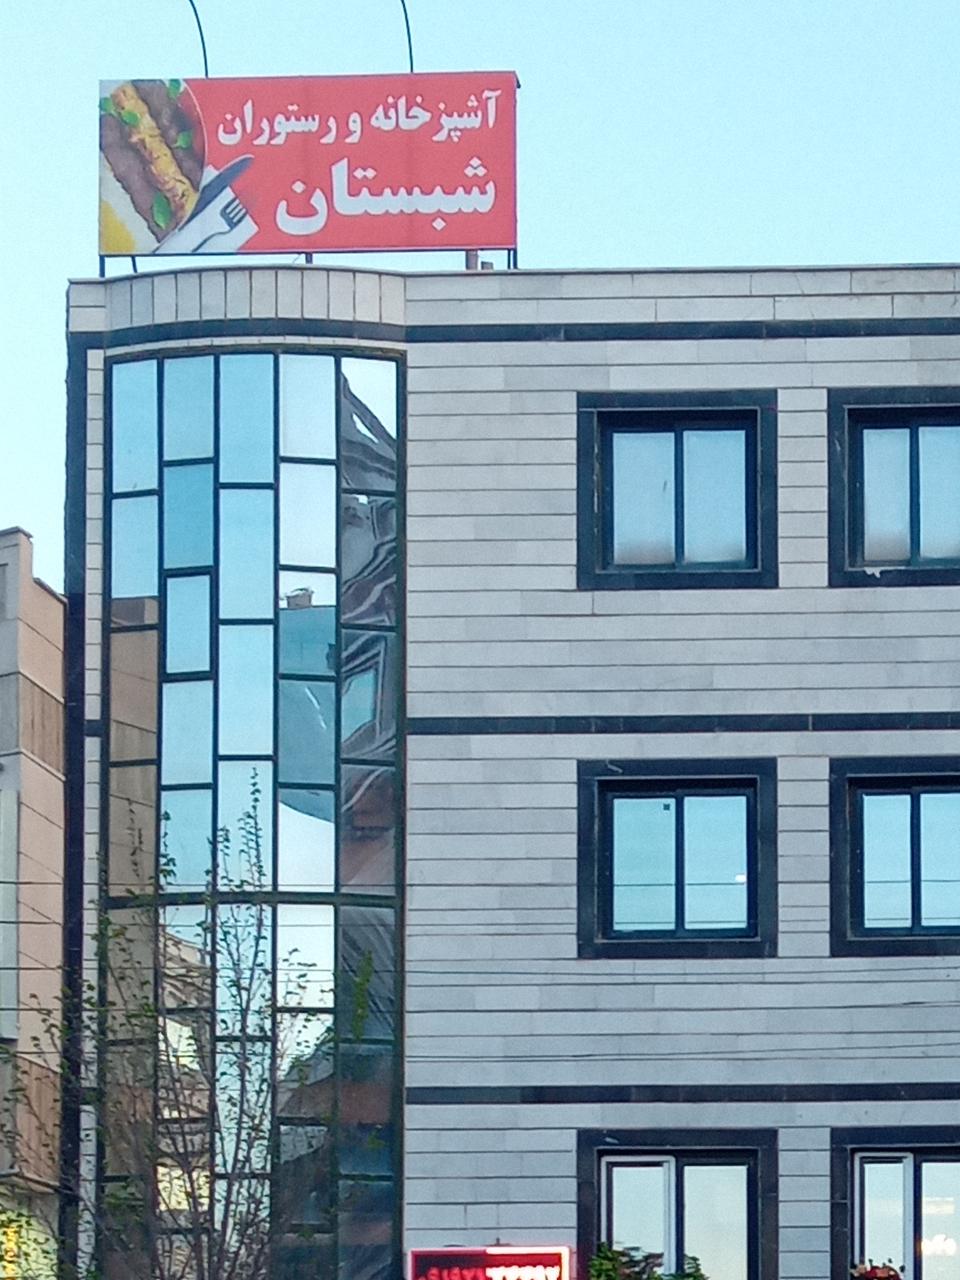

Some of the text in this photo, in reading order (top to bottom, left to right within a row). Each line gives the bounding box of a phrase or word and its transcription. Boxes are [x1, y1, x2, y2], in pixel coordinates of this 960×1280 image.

[217, 90, 502, 146] آشپزخانه و رستوران
[275, 156, 496, 236] شبستان
